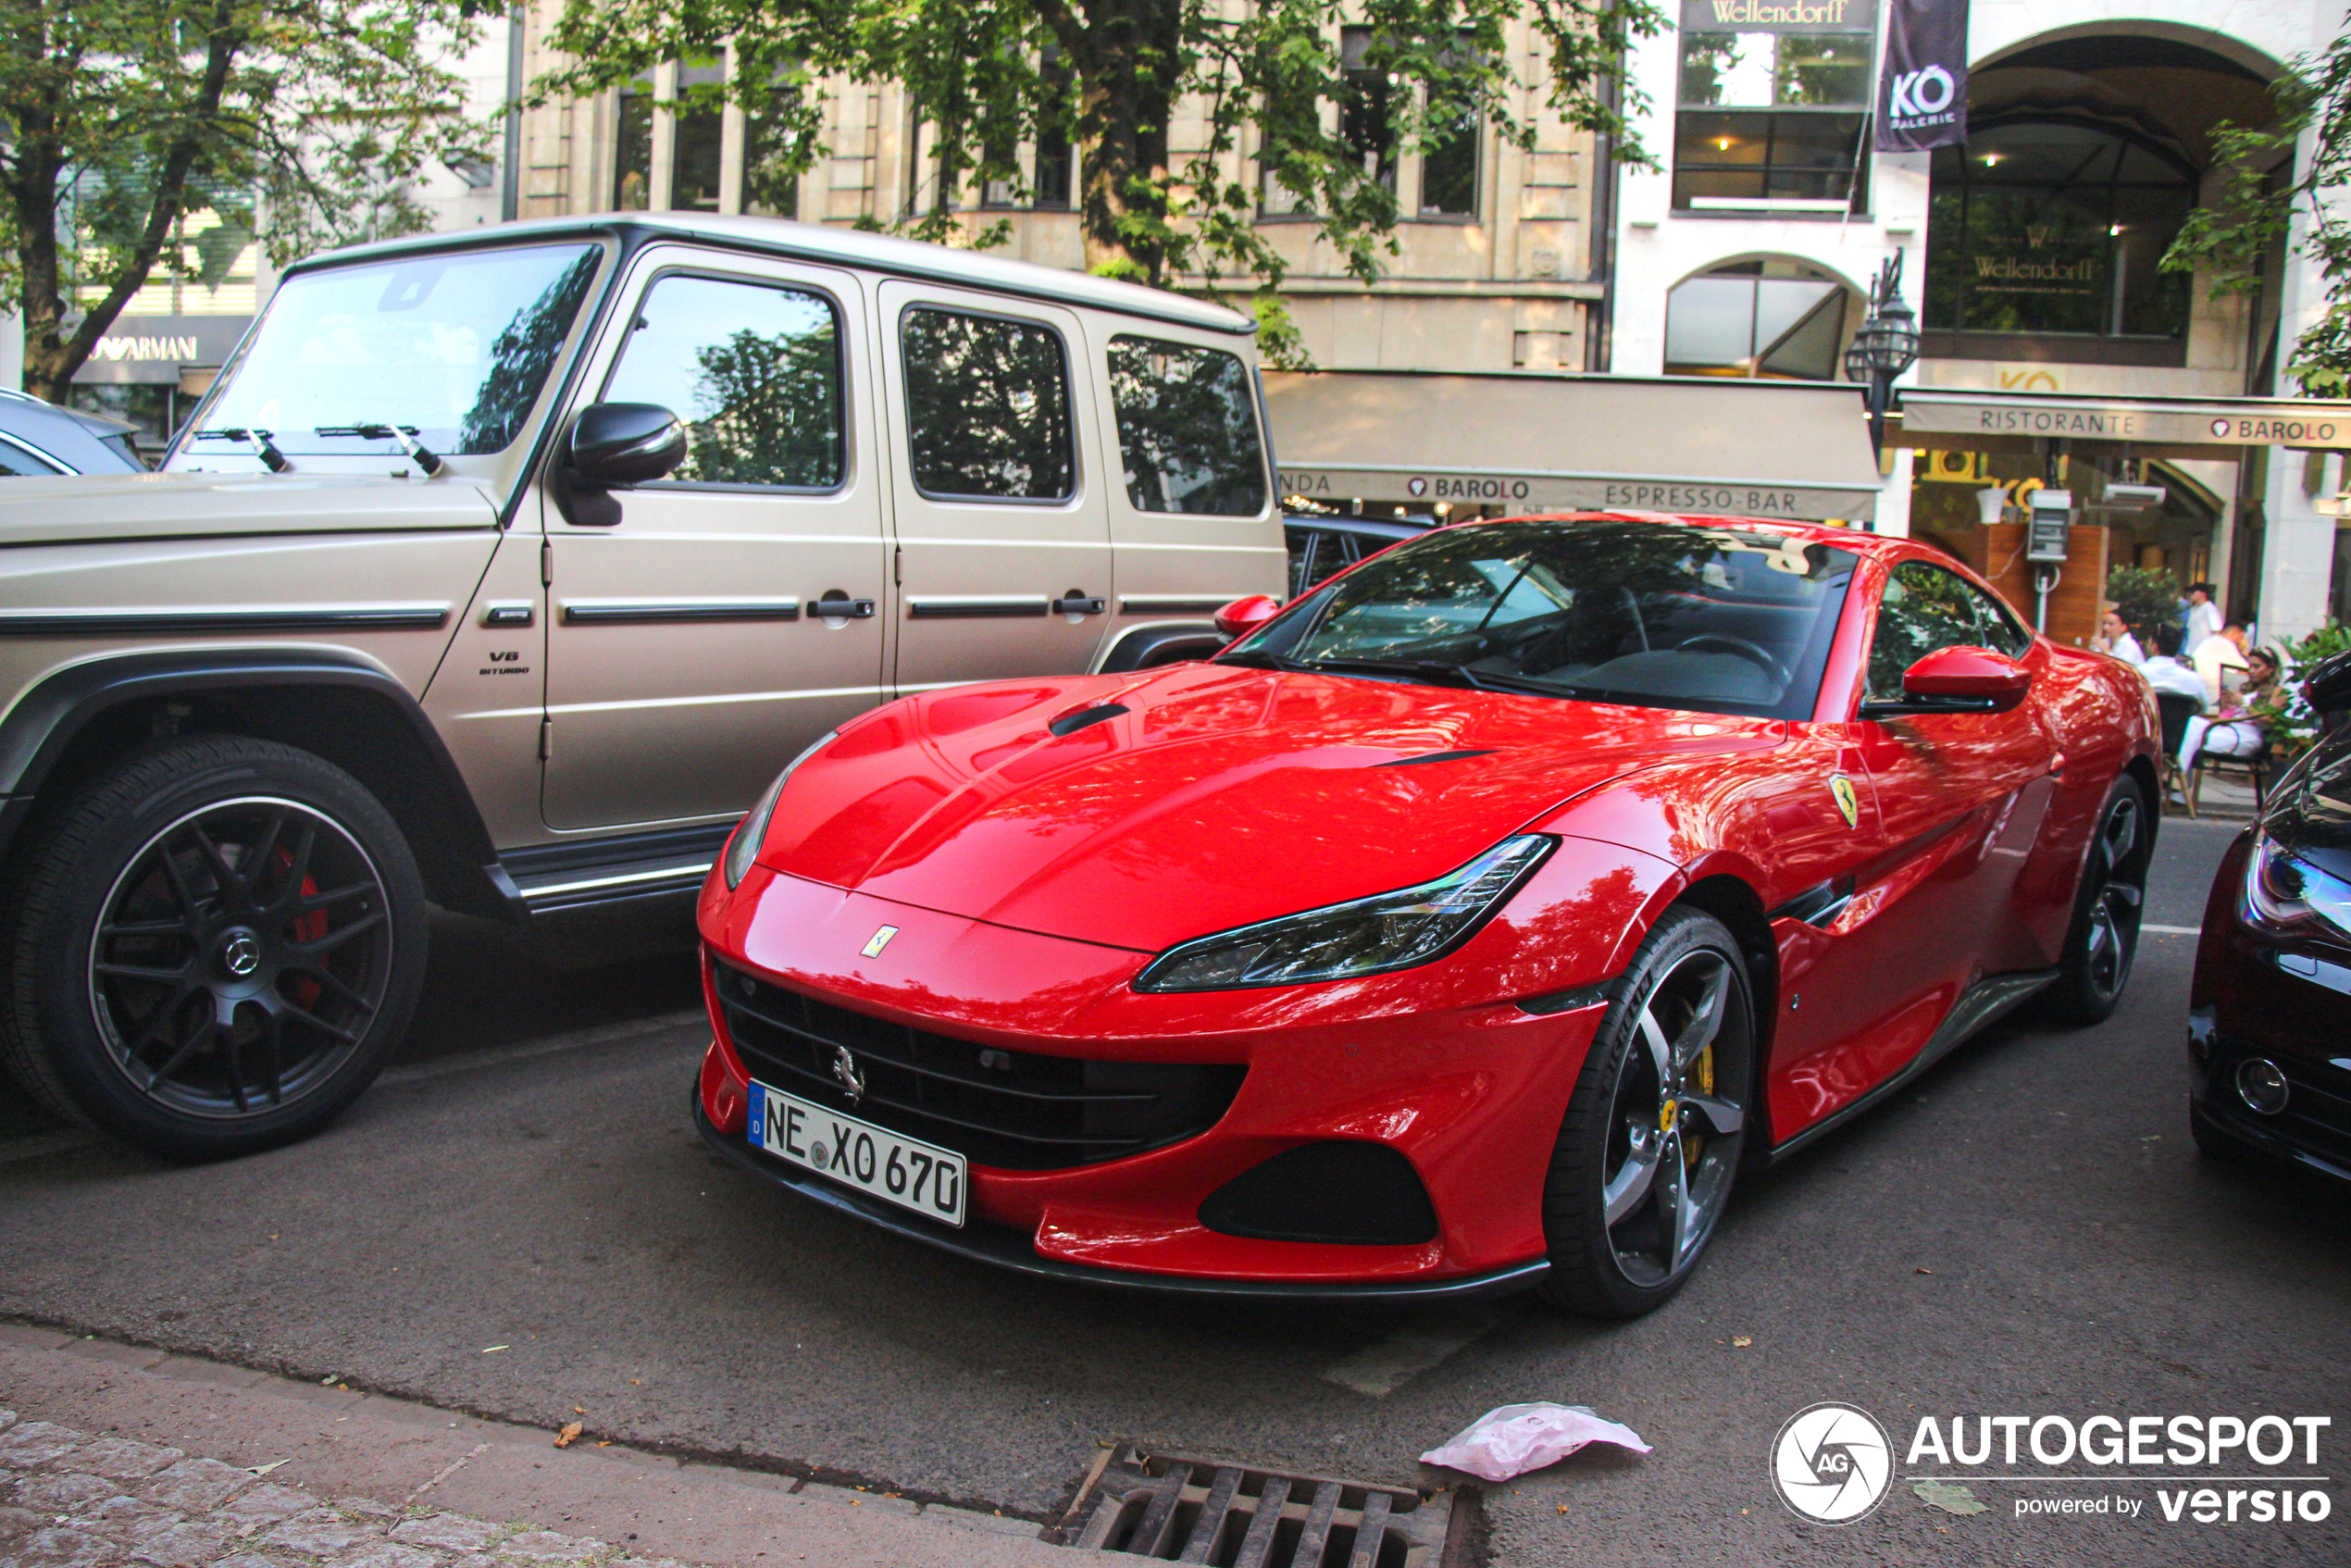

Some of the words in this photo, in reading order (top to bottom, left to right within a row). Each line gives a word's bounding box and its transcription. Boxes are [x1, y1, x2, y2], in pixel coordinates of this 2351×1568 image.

[1711, 0, 1847, 24] Wellendorff
[1975, 255, 2096, 279] Wellendorff
[126, 336, 197, 361] ARMANI
[1981, 410, 2134, 433] RISTORANTE
[2239, 420, 2335, 440] BAROLO
[1436, 479, 1529, 499] BAROLO
[1606, 485, 1796, 511] ESPRESSO-BAR
[490, 652, 519, 661] V8
[479, 667, 529, 676] BITURBO
[753, 1120, 760, 1135] D
[766, 1097, 805, 1158] NE
[830, 1122, 876, 1184] XO
[886, 1145, 959, 1213] 670
